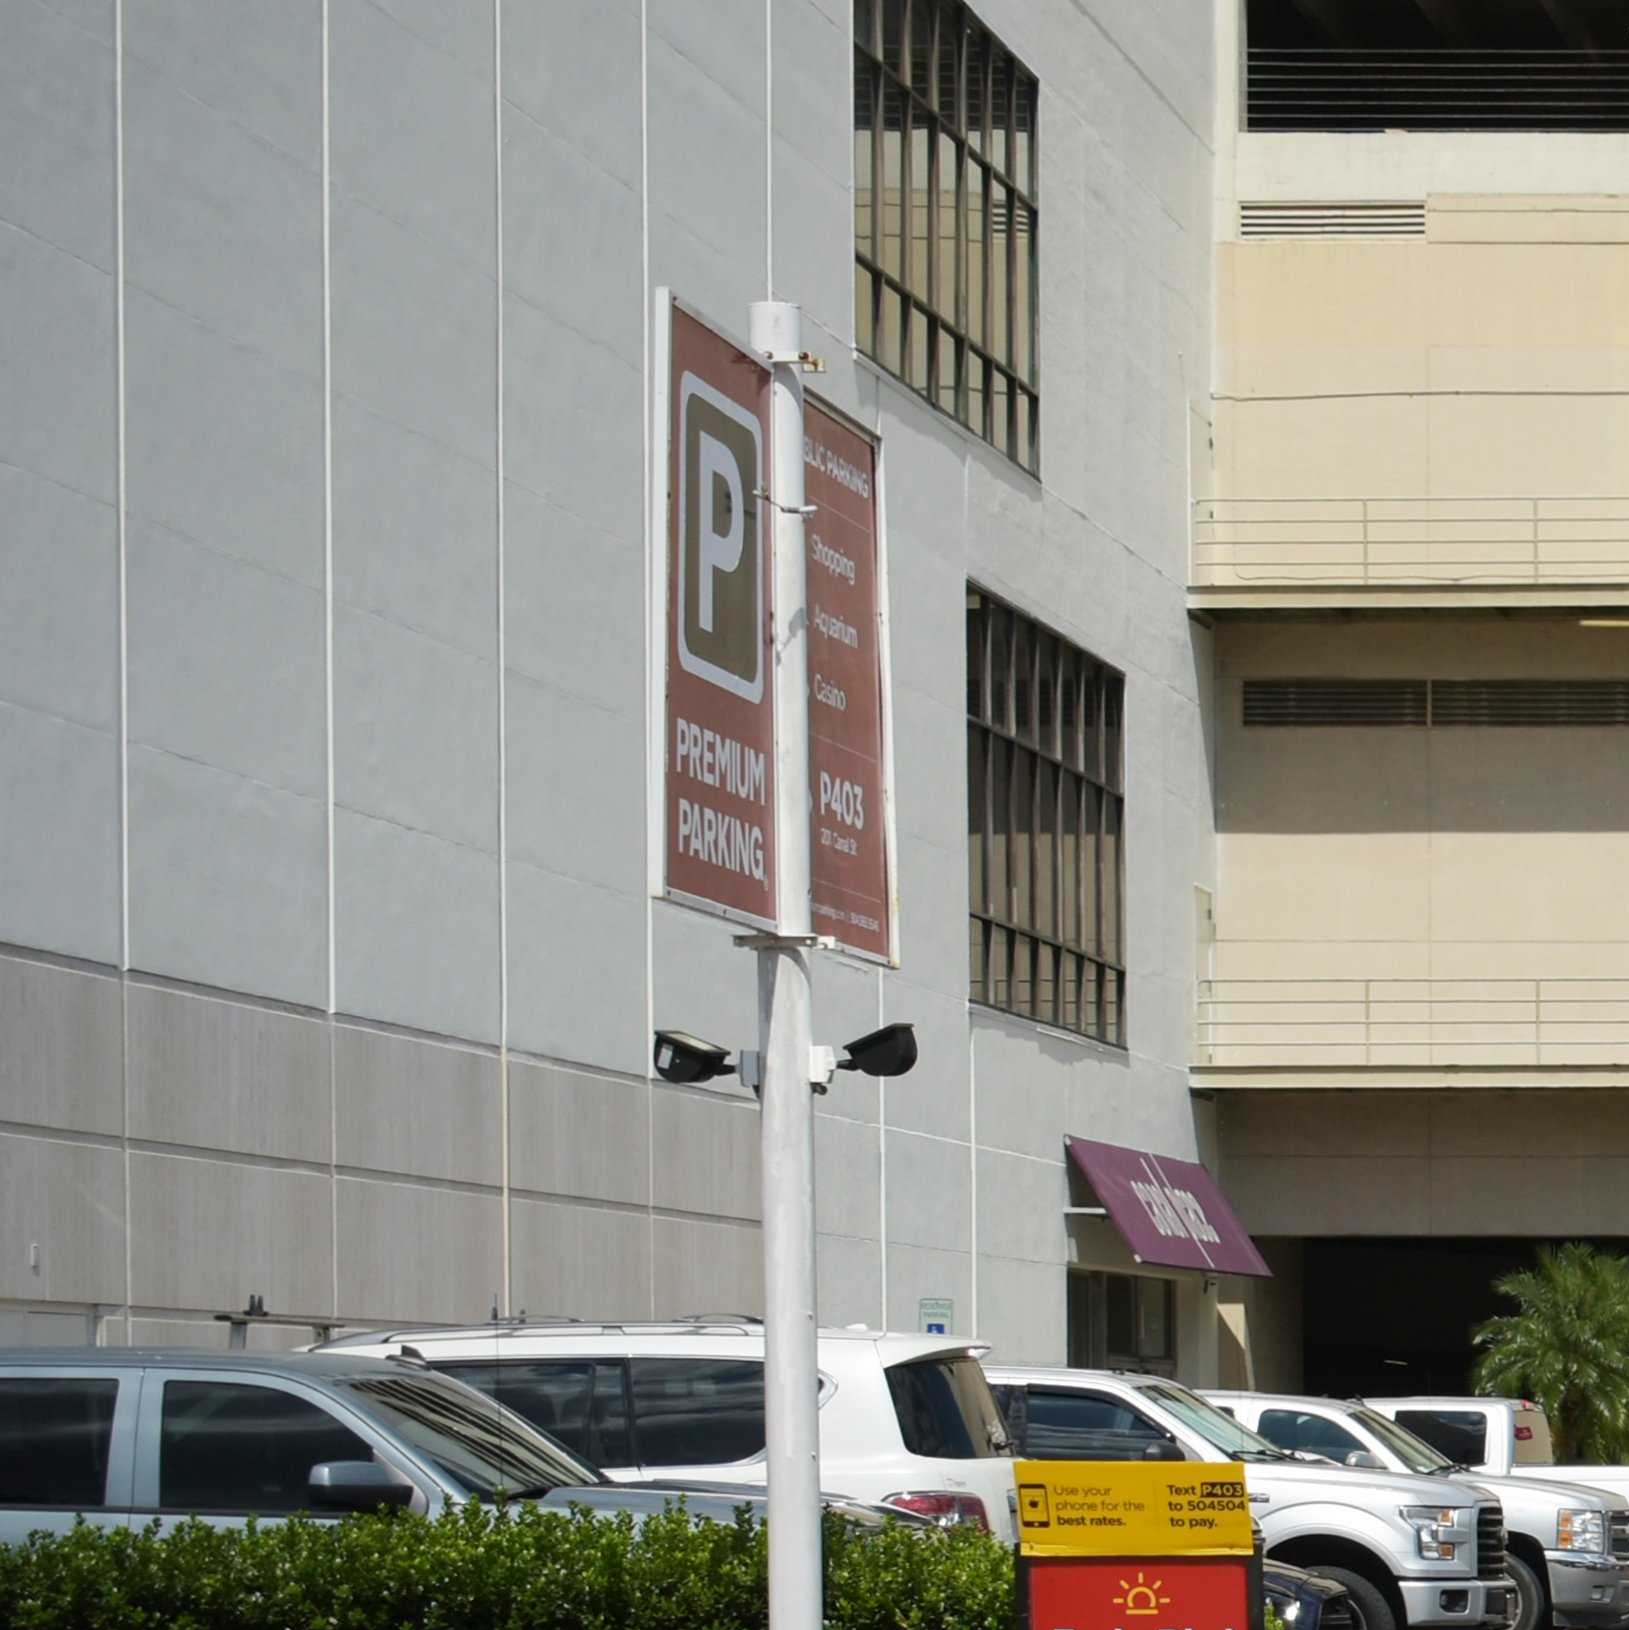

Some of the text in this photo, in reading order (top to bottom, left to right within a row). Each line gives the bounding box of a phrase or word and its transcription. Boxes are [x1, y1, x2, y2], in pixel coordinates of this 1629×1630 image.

[827, 450, 868, 498] PARKING
[698, 430, 744, 634] P
[811, 533, 855, 585] Shopping
[815, 604, 858, 649] Aquarium
[814, 673, 846, 712] Casino
[676, 718, 766, 805] PREMIUM
[819, 770, 865, 831] P403
[678, 797, 764, 882] PARKING
[1053, 1485, 1112, 1498] Use your
[1055, 1500, 1145, 1513] phone for the
[1167, 1484, 1243, 1496] Text P403
[1168, 1500, 1245, 1511] to 504504
[1057, 1515, 1127, 1527] best rates.
[1170, 1516, 1218, 1529] to pay.
